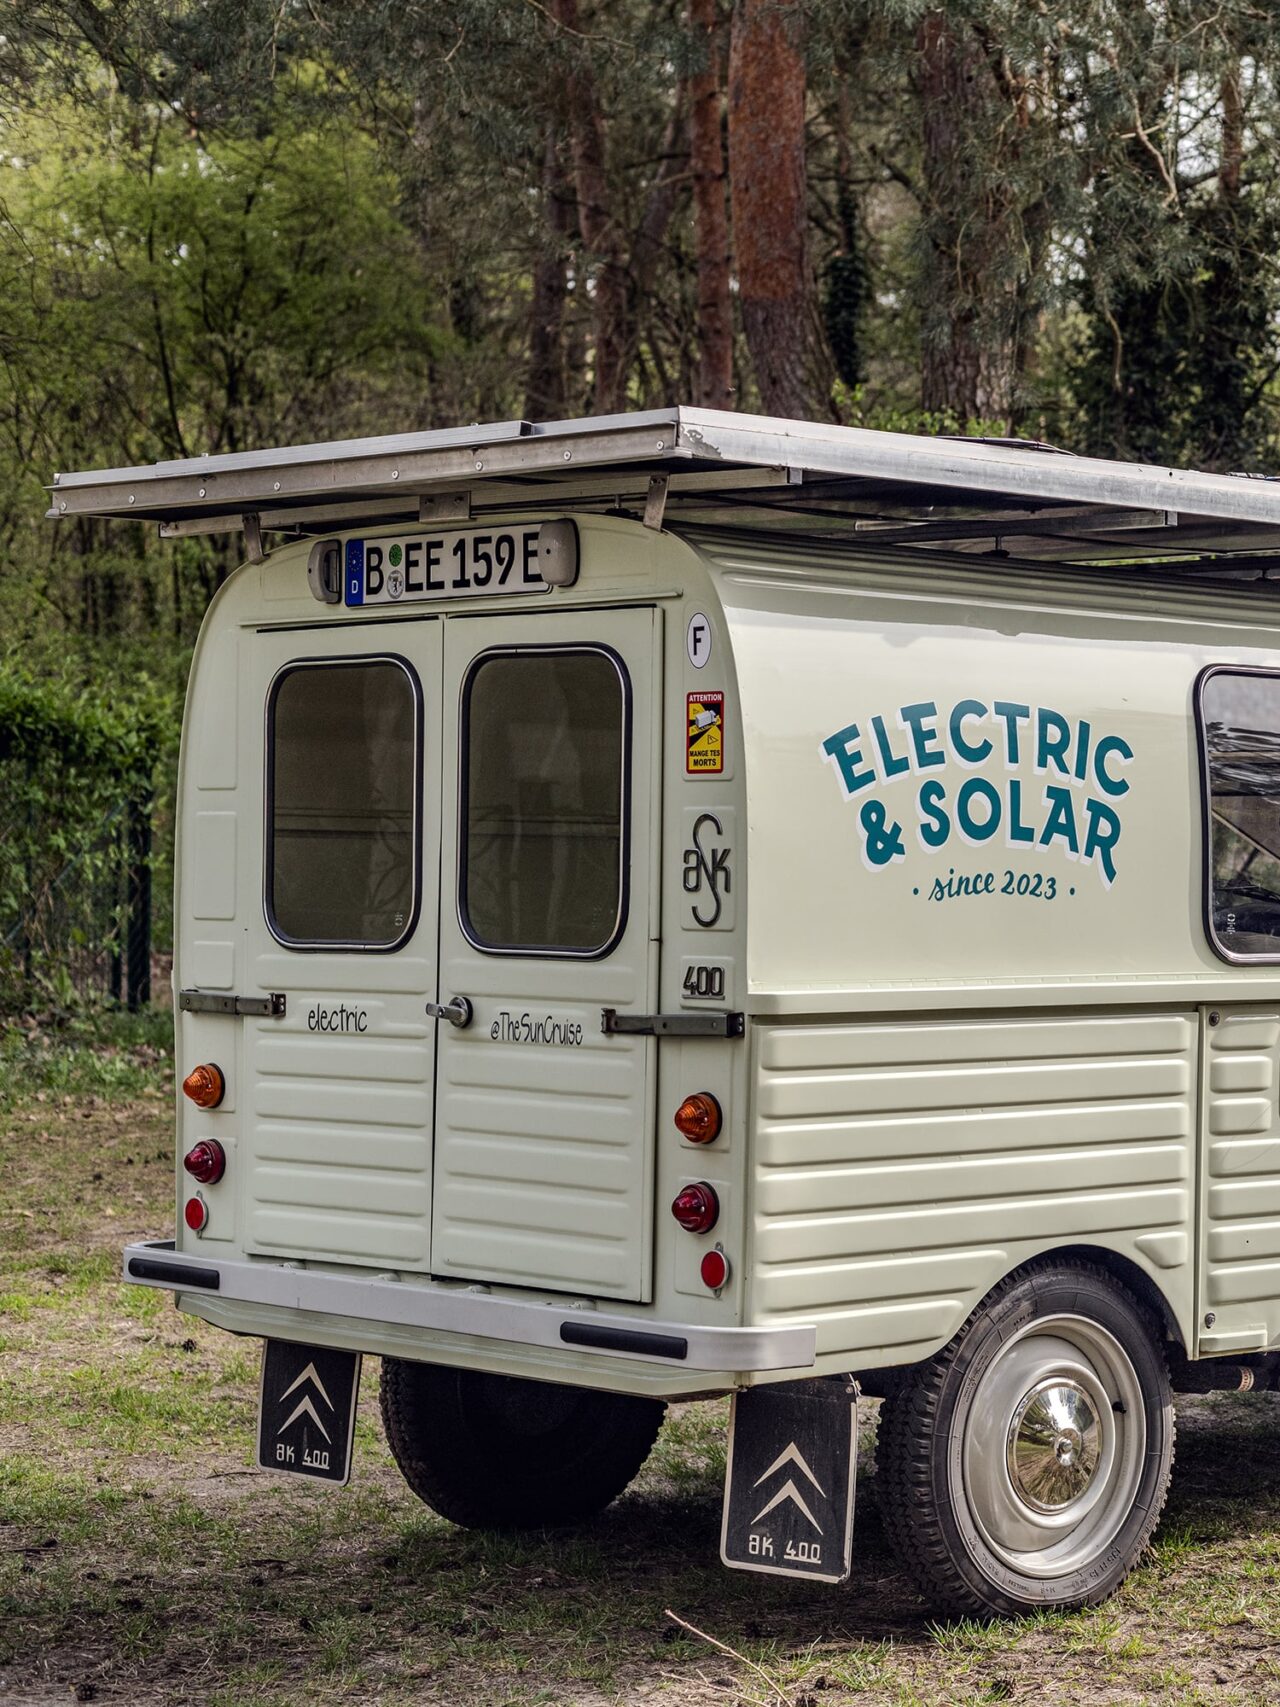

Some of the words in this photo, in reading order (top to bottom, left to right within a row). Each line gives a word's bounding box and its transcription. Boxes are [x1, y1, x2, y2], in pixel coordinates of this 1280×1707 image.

[365, 546, 384, 596] B
[352, 580, 359, 594] D
[693, 626, 705, 656] F
[689, 693, 722, 702] ATTENTION
[693, 758, 717, 767] MORTS
[710, 749, 721, 757] TES
[821, 698, 1135, 797] ELECTRIC
[859, 799, 906, 866] &
[919, 777, 1121, 885] SOLAR
[928, 867, 995, 901] since
[1000, 869, 1057, 900] 2023
[683, 966, 726, 1000] 400
[308, 1002, 368, 1032] electric
[490, 1012, 583, 1046] @TheSunCruise
[302, 1448, 330, 1470] 400
[783, 1540, 822, 1564] 400
